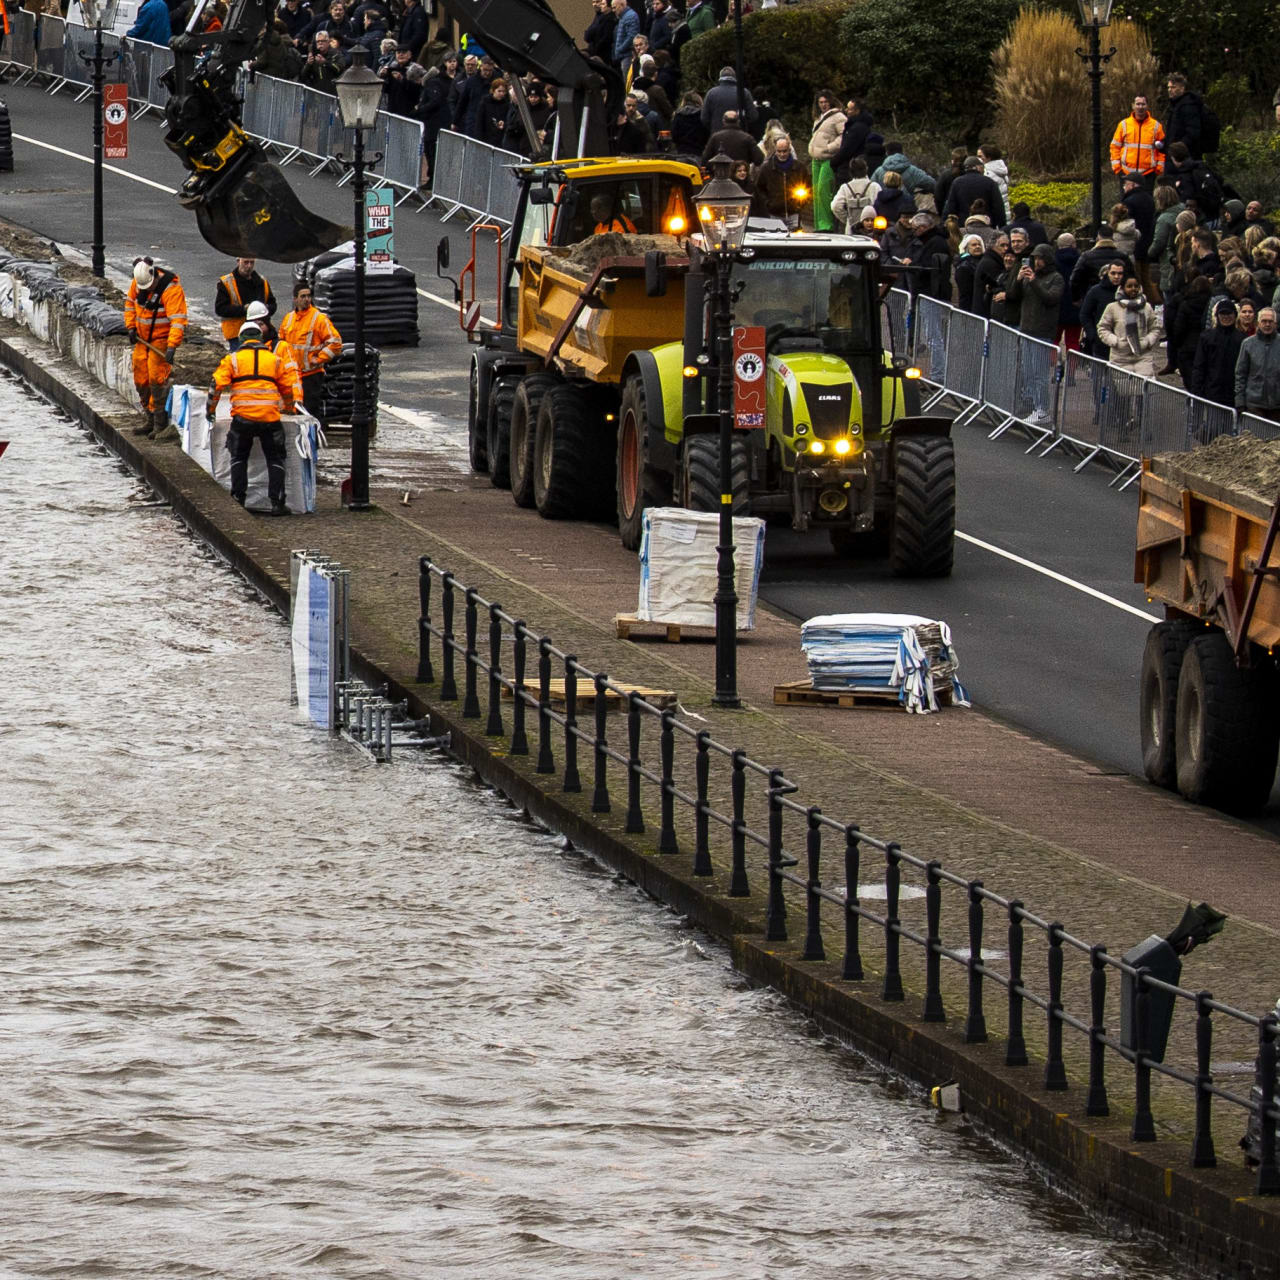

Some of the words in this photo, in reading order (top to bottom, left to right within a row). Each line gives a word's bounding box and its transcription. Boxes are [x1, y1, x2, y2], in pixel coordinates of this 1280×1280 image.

[368, 206, 389, 216] WHAT
[372, 218, 387, 227] THE
[749, 262, 795, 270] UNICOM
[796, 262, 827, 270] OOST
